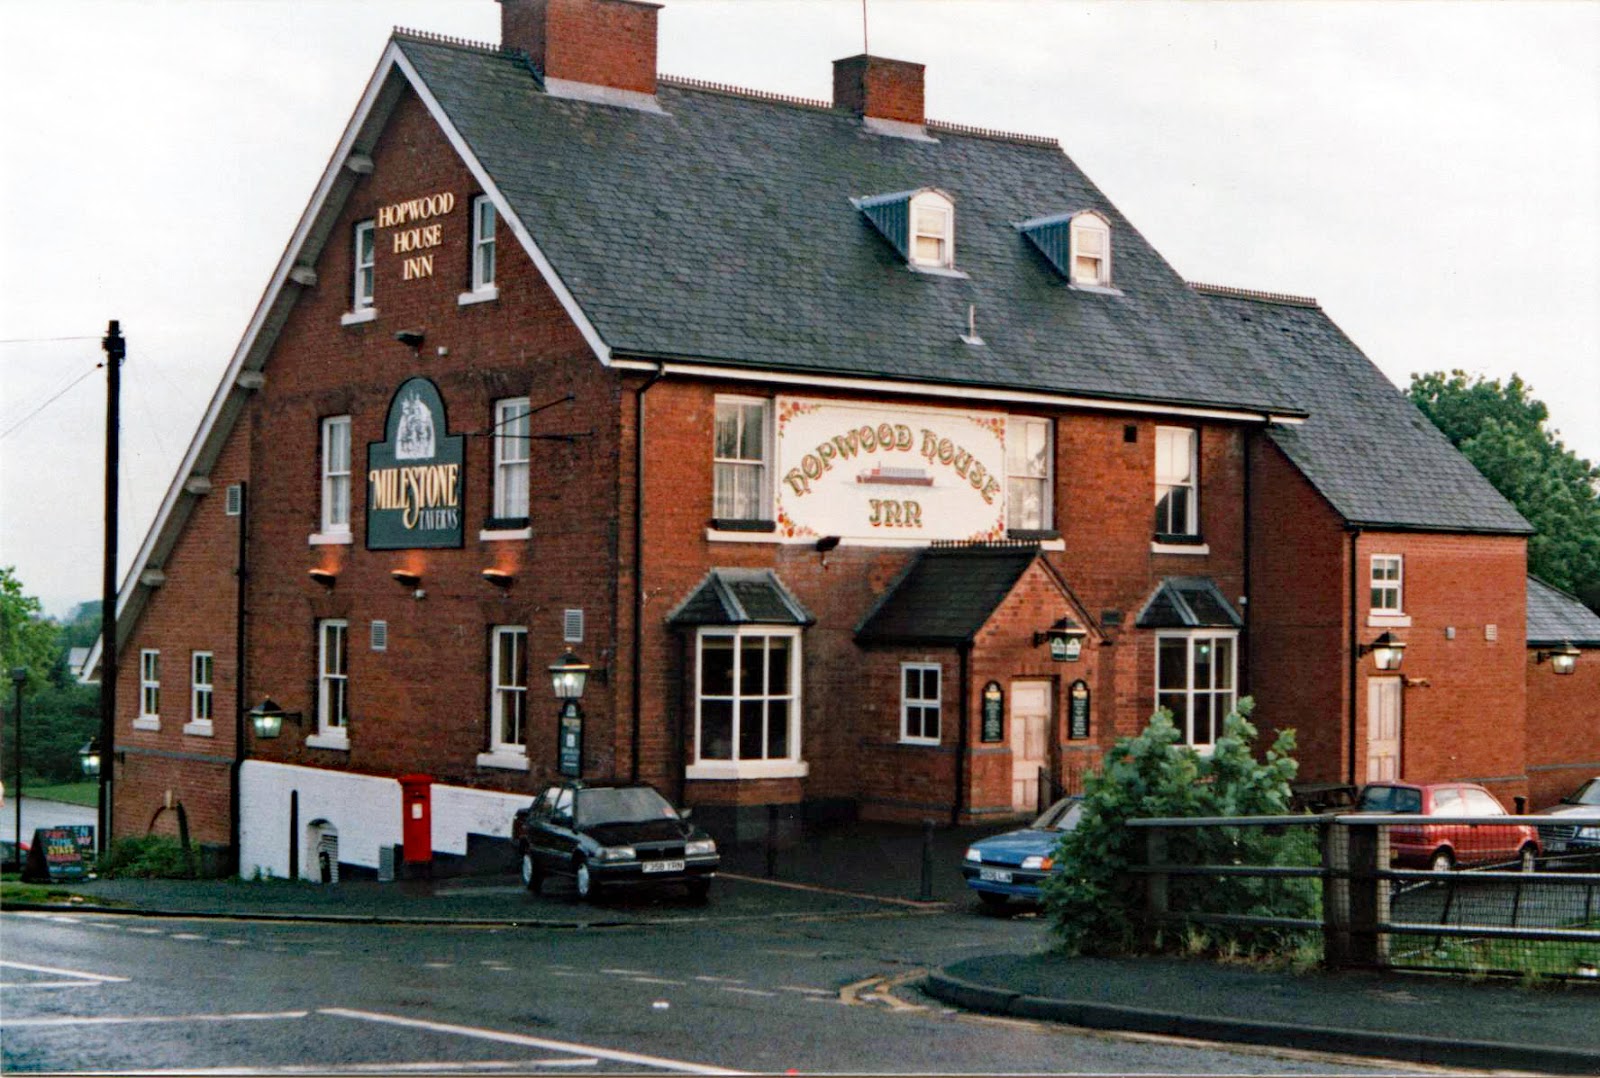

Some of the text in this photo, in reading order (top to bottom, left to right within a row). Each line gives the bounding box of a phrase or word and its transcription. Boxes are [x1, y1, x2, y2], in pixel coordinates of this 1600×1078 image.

[378, 192, 454, 228] HOPWOOD
[393, 223, 442, 254] HOUSE
[403, 254, 434, 280] INN
[369, 463, 459, 529] MILESTONE
[419, 509, 458, 530] TAVERNS
